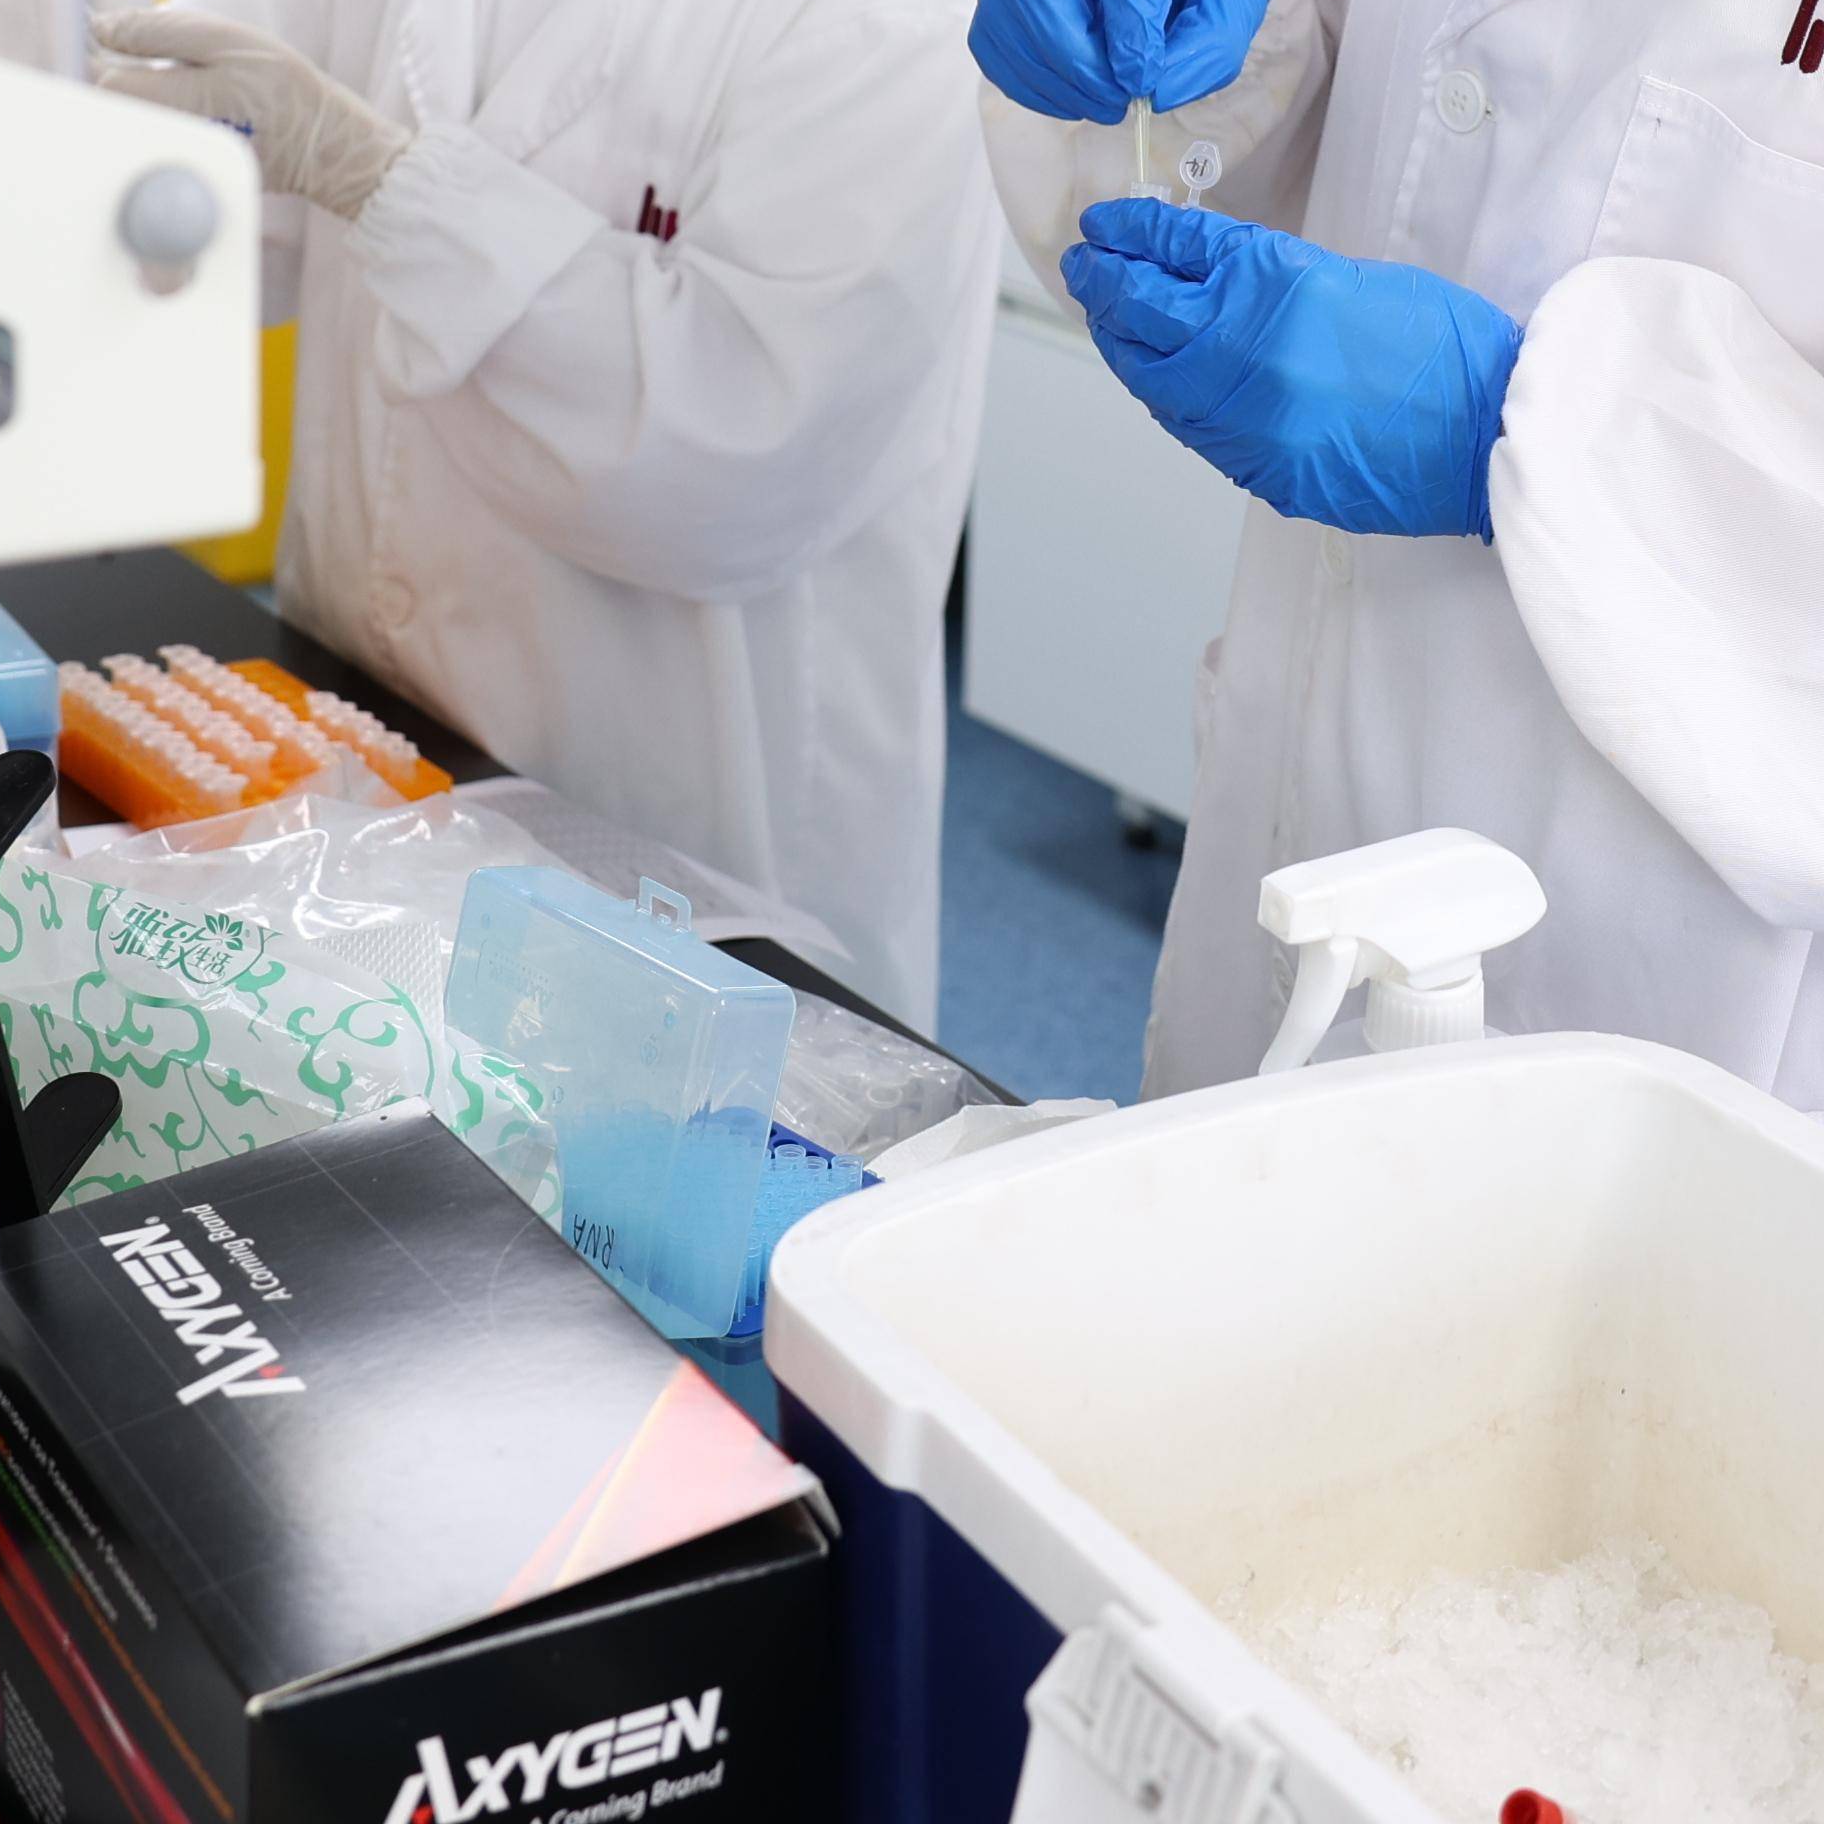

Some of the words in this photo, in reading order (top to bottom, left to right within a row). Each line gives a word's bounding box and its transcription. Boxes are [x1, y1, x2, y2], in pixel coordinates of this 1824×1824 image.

[182, 1203, 237, 1243] Brand
[573, 1213, 615, 1270] RNA
[222, 1238, 279, 1290] Corning
[99, 1223, 307, 1406] AXYGEN
[262, 1287, 292, 1301] A
[382, 1686, 722, 1824] AXYGEN
[650, 1759, 724, 1808] Brand
